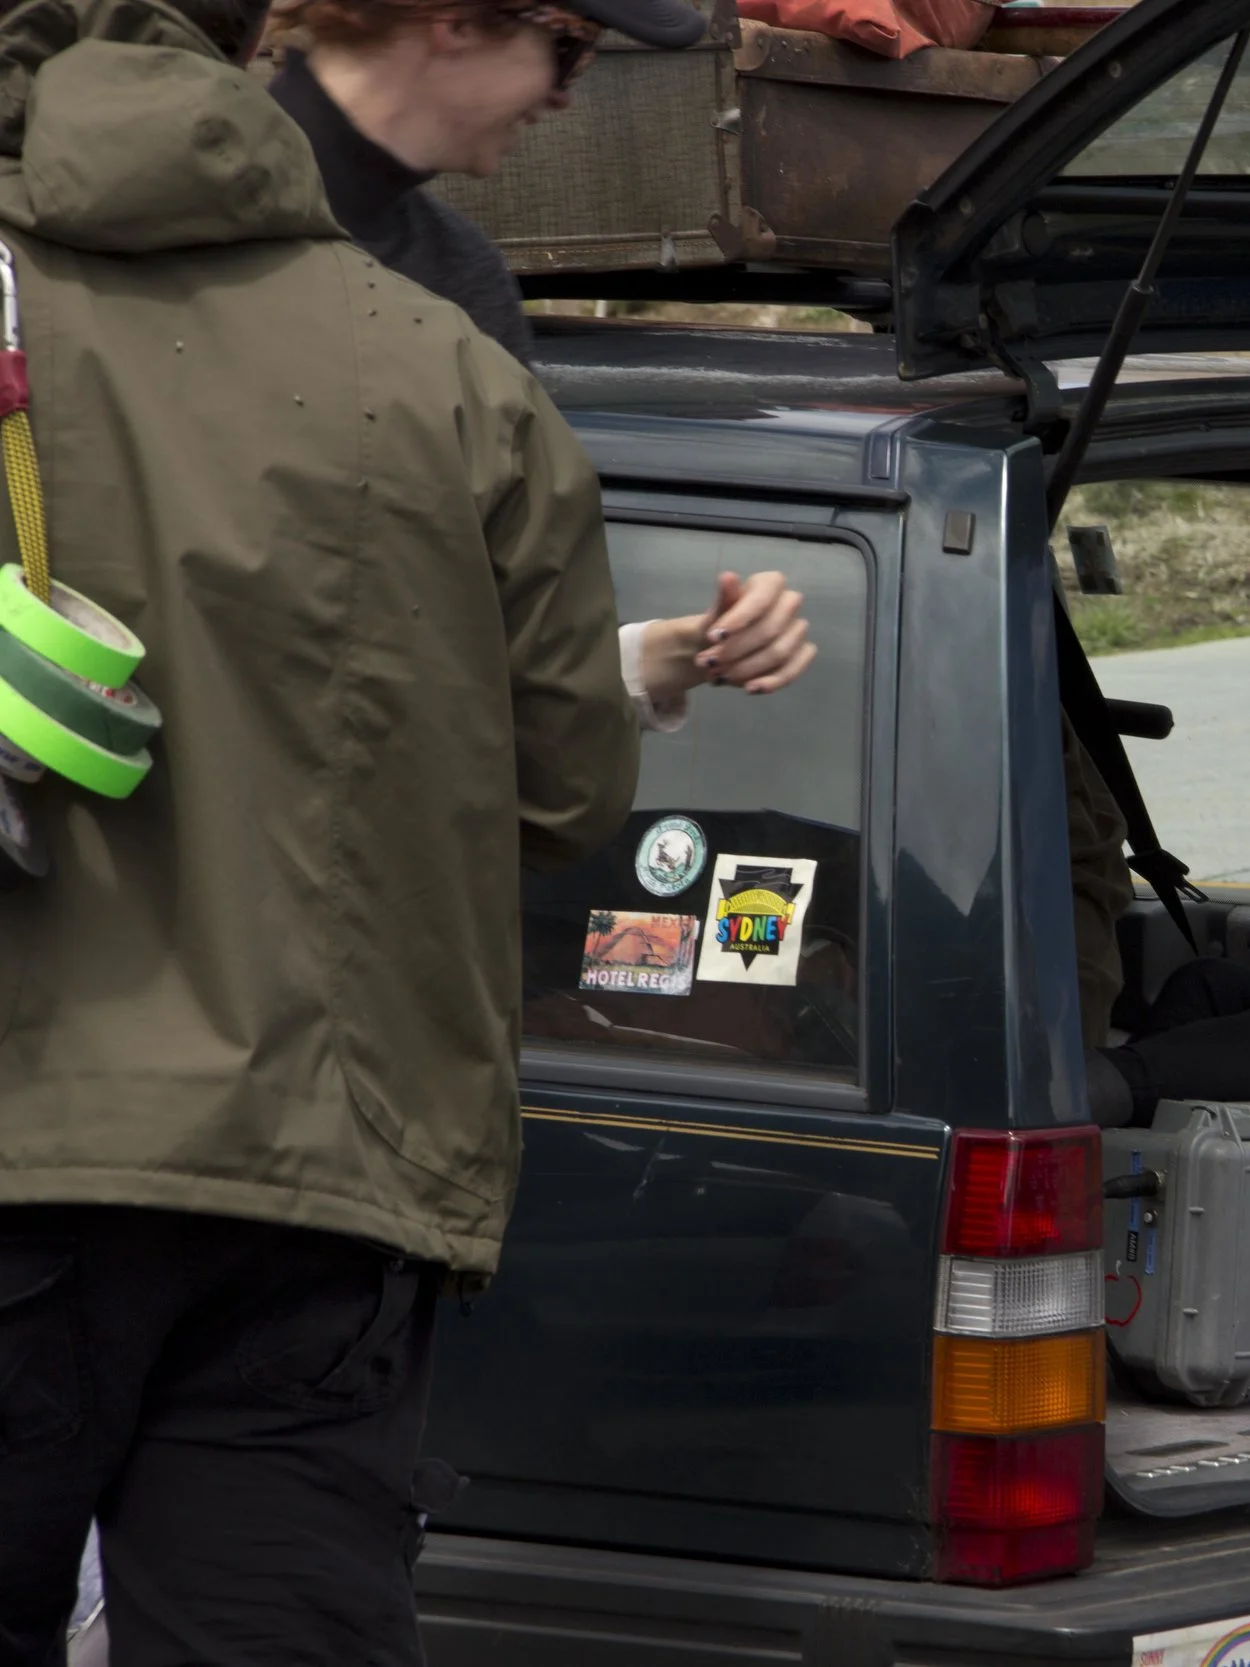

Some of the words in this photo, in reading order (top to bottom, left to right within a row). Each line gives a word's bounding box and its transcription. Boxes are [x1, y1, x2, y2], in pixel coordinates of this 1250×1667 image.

[716, 914, 789, 943] SYDNEY
[730, 943, 770, 952] AUSTRALIA
[587, 968, 634, 987] HOTEL
